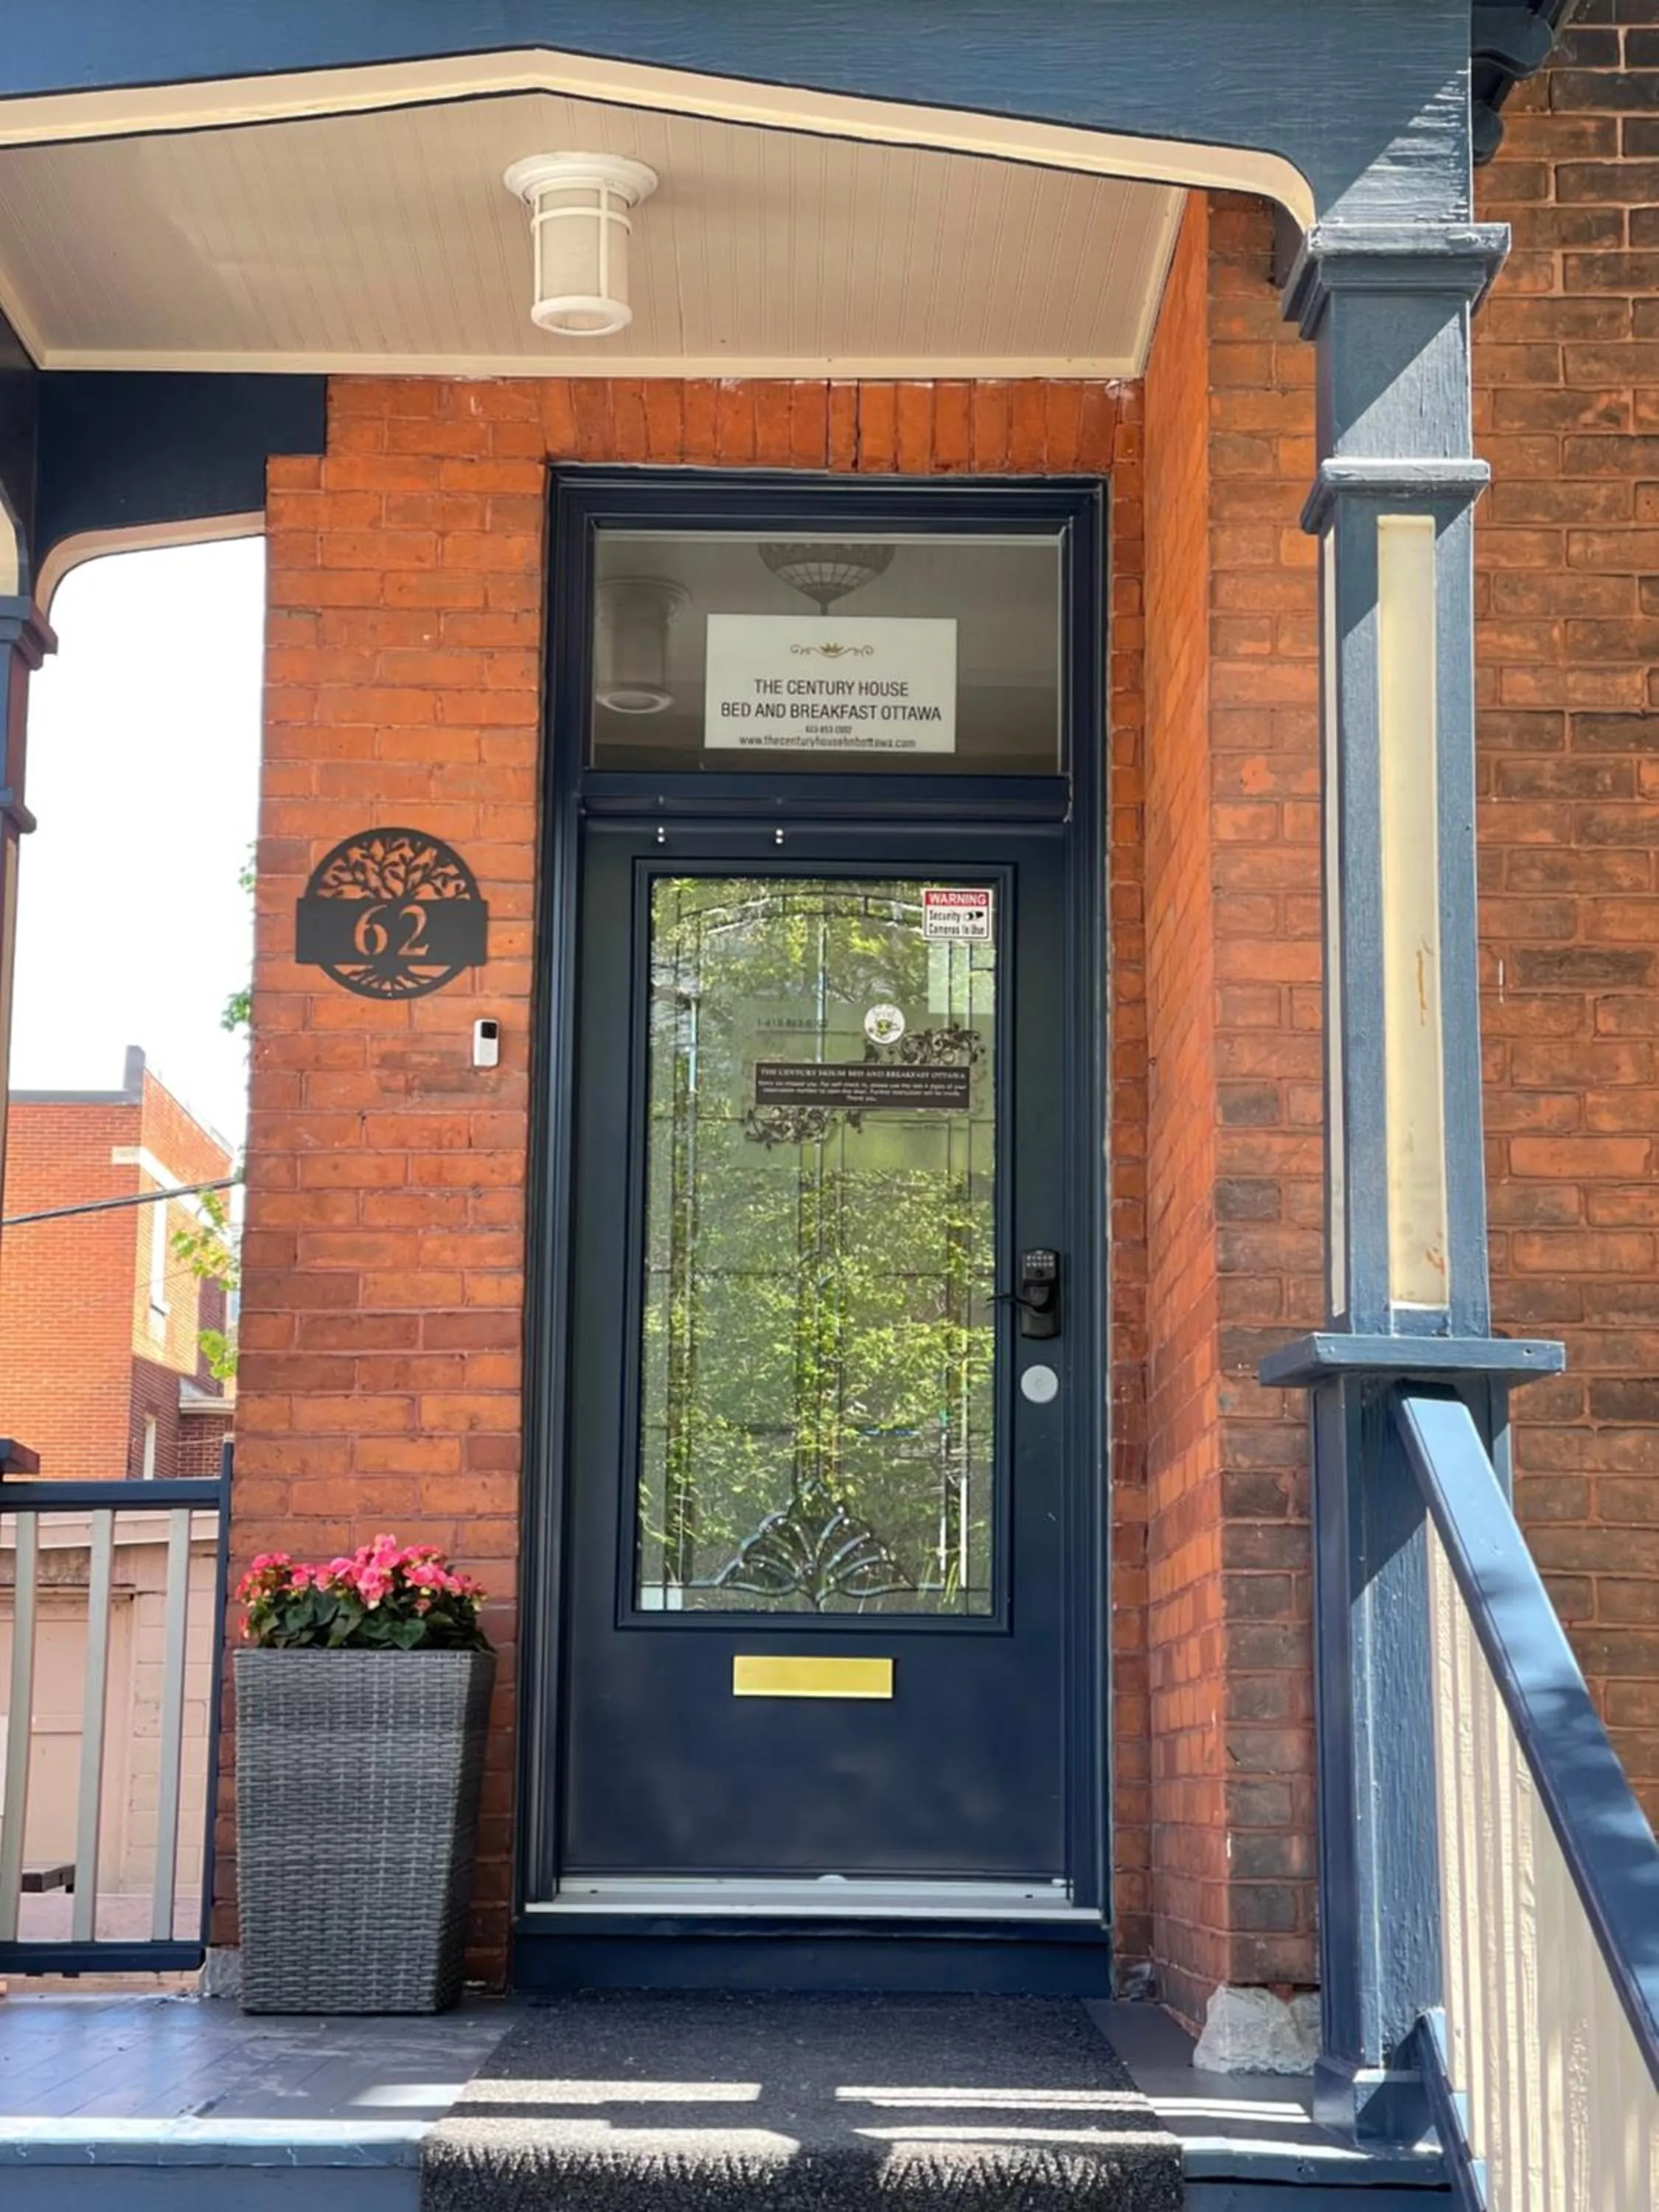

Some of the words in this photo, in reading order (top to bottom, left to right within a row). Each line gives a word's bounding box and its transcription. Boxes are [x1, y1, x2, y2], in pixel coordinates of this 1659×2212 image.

[754, 679, 784, 695] THE
[787, 680, 855, 696] CENTURY
[858, 681, 909, 697] HOUSE
[721, 703, 751, 717] BED
[755, 703, 786, 719] AND
[790, 704, 877, 720] BREAKFAST
[881, 706, 942, 721] OTTAWA
[928, 892, 987, 905] WARNING
[929, 910, 961, 922] Security
[354, 904, 430, 957] 62
[929, 923, 960, 934] Cameras
[866, 1070, 885, 1078] AND
